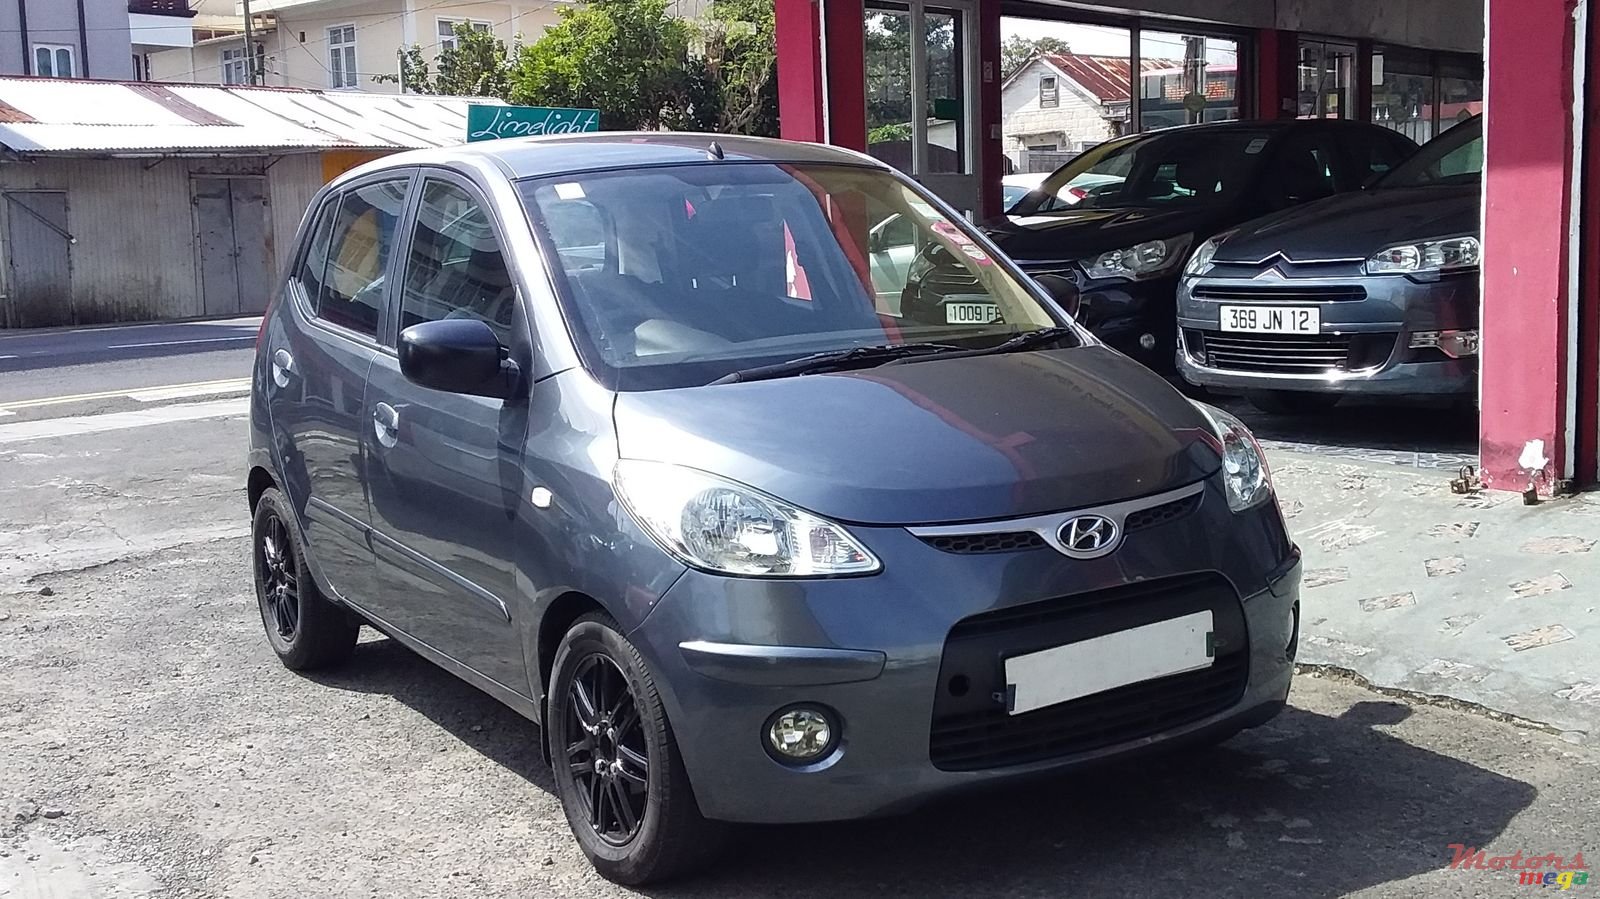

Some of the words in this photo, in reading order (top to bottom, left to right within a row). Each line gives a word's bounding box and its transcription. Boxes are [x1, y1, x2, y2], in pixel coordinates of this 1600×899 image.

[471, 107, 596, 139] Limelight
[952, 306, 982, 321] 1009
[1230, 309, 1257, 329] 369
[1263, 310, 1282, 330] JN
[1291, 310, 1309, 330] 12
